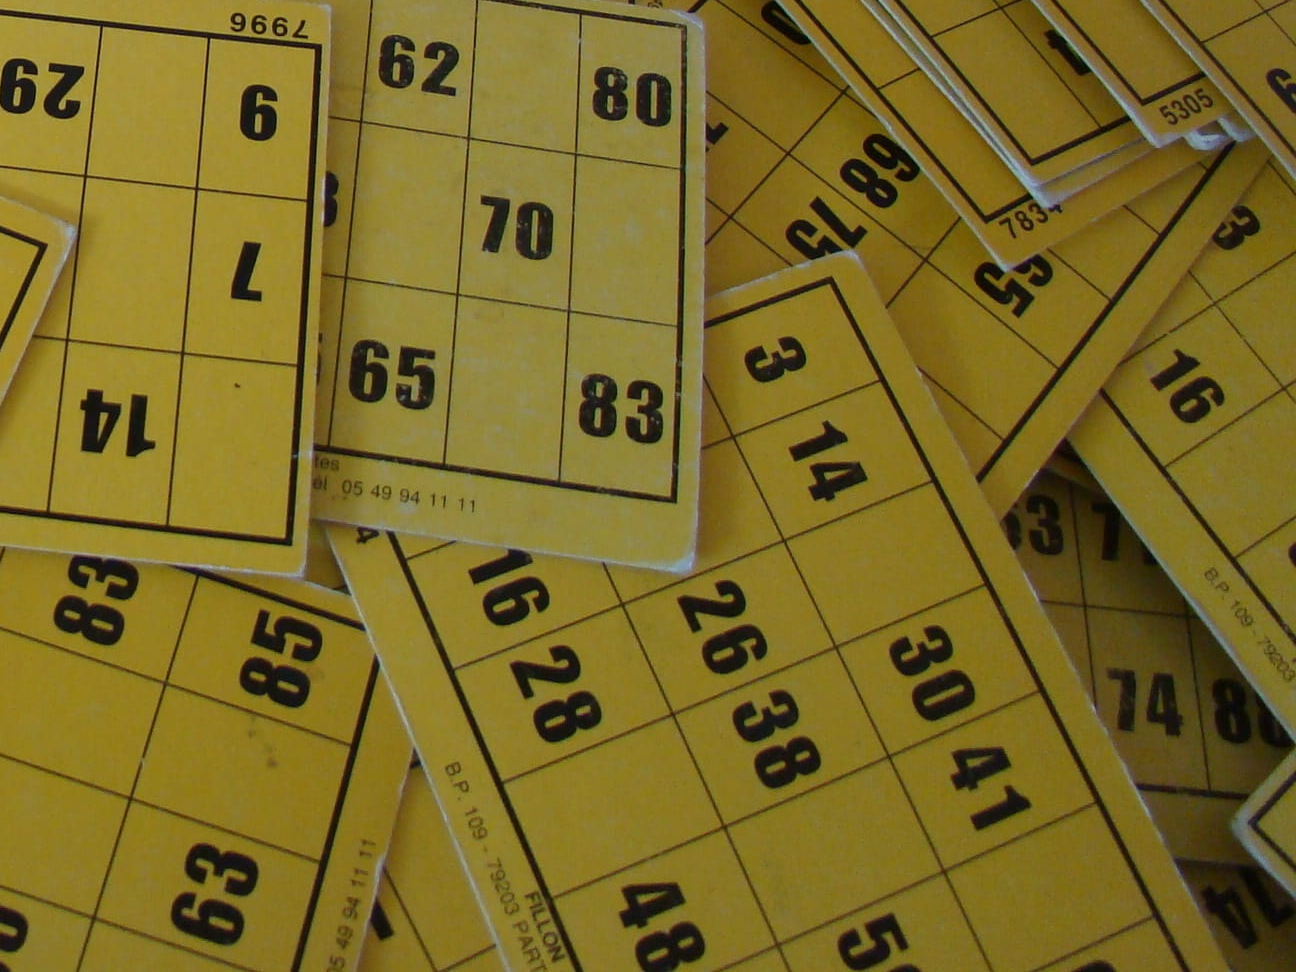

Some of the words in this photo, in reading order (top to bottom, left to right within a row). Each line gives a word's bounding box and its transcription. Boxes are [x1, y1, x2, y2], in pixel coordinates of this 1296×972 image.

[230, 12, 309, 40] 7996
[592, 66, 673, 128] 80
[1158, 88, 1214, 126] 5305
[839, 133, 922, 209] 68
[480, 195, 555, 261] 70
[348, 339, 436, 411] 65
[578, 373, 664, 445] 83
[1151, 349, 1226, 424] 16
[79, 389, 156, 458] 14
[342, 479, 363, 496] 05
[370, 483, 392, 500] 49
[399, 488, 420, 505] 94
[430, 493, 447, 509] 11
[458, 497, 476, 513] 11
[789, 420, 869, 503] 14
[239, 610, 323, 709] 85
[677, 580, 769, 676] 26
[509, 645, 603, 744] 28
[1108, 668, 1184, 738] 74
[732, 690, 822, 790] 38
[951, 747, 1032, 832] 41
[465, 806, 488, 841] 109
[486, 857, 520, 916] 79203
[525, 890, 565, 963] FILLON
